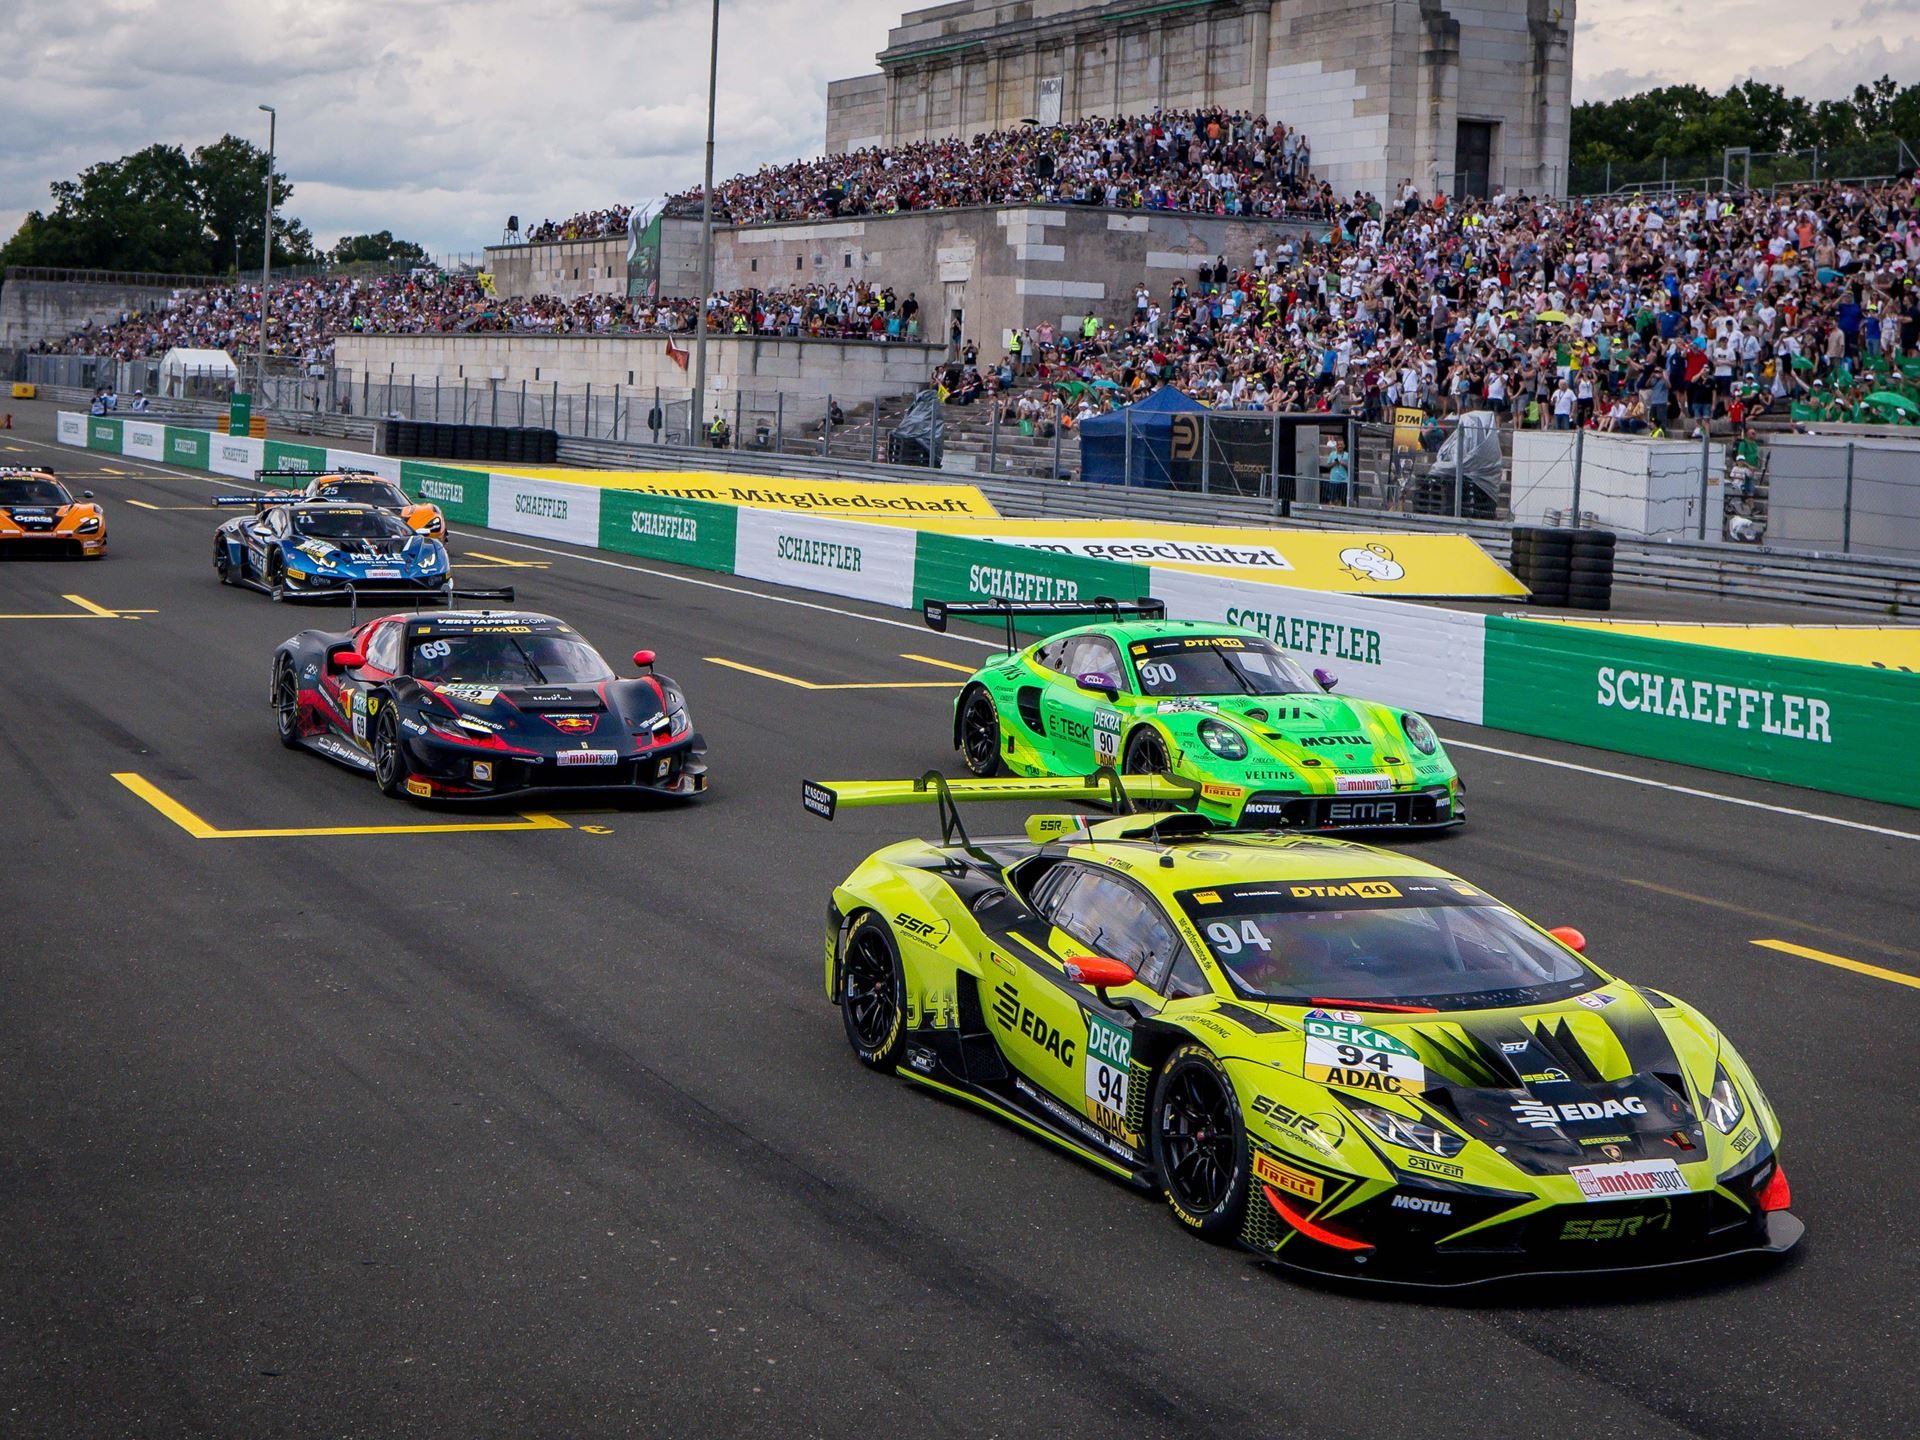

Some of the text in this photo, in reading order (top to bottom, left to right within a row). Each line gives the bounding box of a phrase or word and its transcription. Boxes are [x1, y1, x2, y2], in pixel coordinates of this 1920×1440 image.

[1397, 415, 1420, 424] DTM
[324, 487, 338, 495] 25
[421, 479, 463, 503] SCHAEFFLER
[297, 515, 315, 524] 71
[515, 494, 568, 520] SCHAEFFLER
[631, 511, 697, 541] SCHAEFFLER
[350, 553, 404, 561] MEYLE
[777, 536, 862, 572] SCHAEFFLER
[1084, 542, 1284, 567] geschützt
[969, 564, 1078, 602] SCHAEFFLER
[437, 617, 547, 625] VERSTAPPEN.COM
[1184, 639, 1241, 647] DTM 40
[1226, 607, 1382, 664] SCHAEFFLER
[420, 640, 451, 660] 69
[1142, 662, 1178, 686] 90
[1597, 666, 1832, 743] SCHAEFFLER
[1094, 711, 1121, 732] DEKRA
[1099, 732, 1114, 754] 90
[1300, 735, 1372, 748] MOTUL
[1245, 771, 1296, 780] VELTINS
[1204, 784, 1241, 797] PIRELLI
[1245, 804, 1282, 814] MOTUL
[1040, 820, 1062, 831] SSR
[1289, 886, 1356, 898] DTM
[1361, 885, 1392, 895] 40
[893, 912, 936, 937] SSR
[1207, 920, 1272, 954] 94
[900, 930, 938, 950] PERFORMANCE
[1021, 1007, 1076, 1068] EDAG
[1197, 1016, 1232, 1039] HOLDING
[1088, 1021, 1131, 1068] DEKR
[1336, 1044, 1393, 1073] 94
[1098, 1065, 1123, 1111] 94
[1326, 1067, 1402, 1093] ADAC
[1251, 1094, 1320, 1134] SSR
[1558, 1096, 1648, 1122] EDAG
[1096, 1103, 1127, 1141] ADAC
[1263, 1119, 1333, 1157] PERFORMANCE
[1257, 1157, 1316, 1197] PIRELLI
[1597, 1167, 1689, 1194] motorsport
[1391, 1195, 1452, 1216] MOTUL
[1559, 1215, 1645, 1241] SSR
